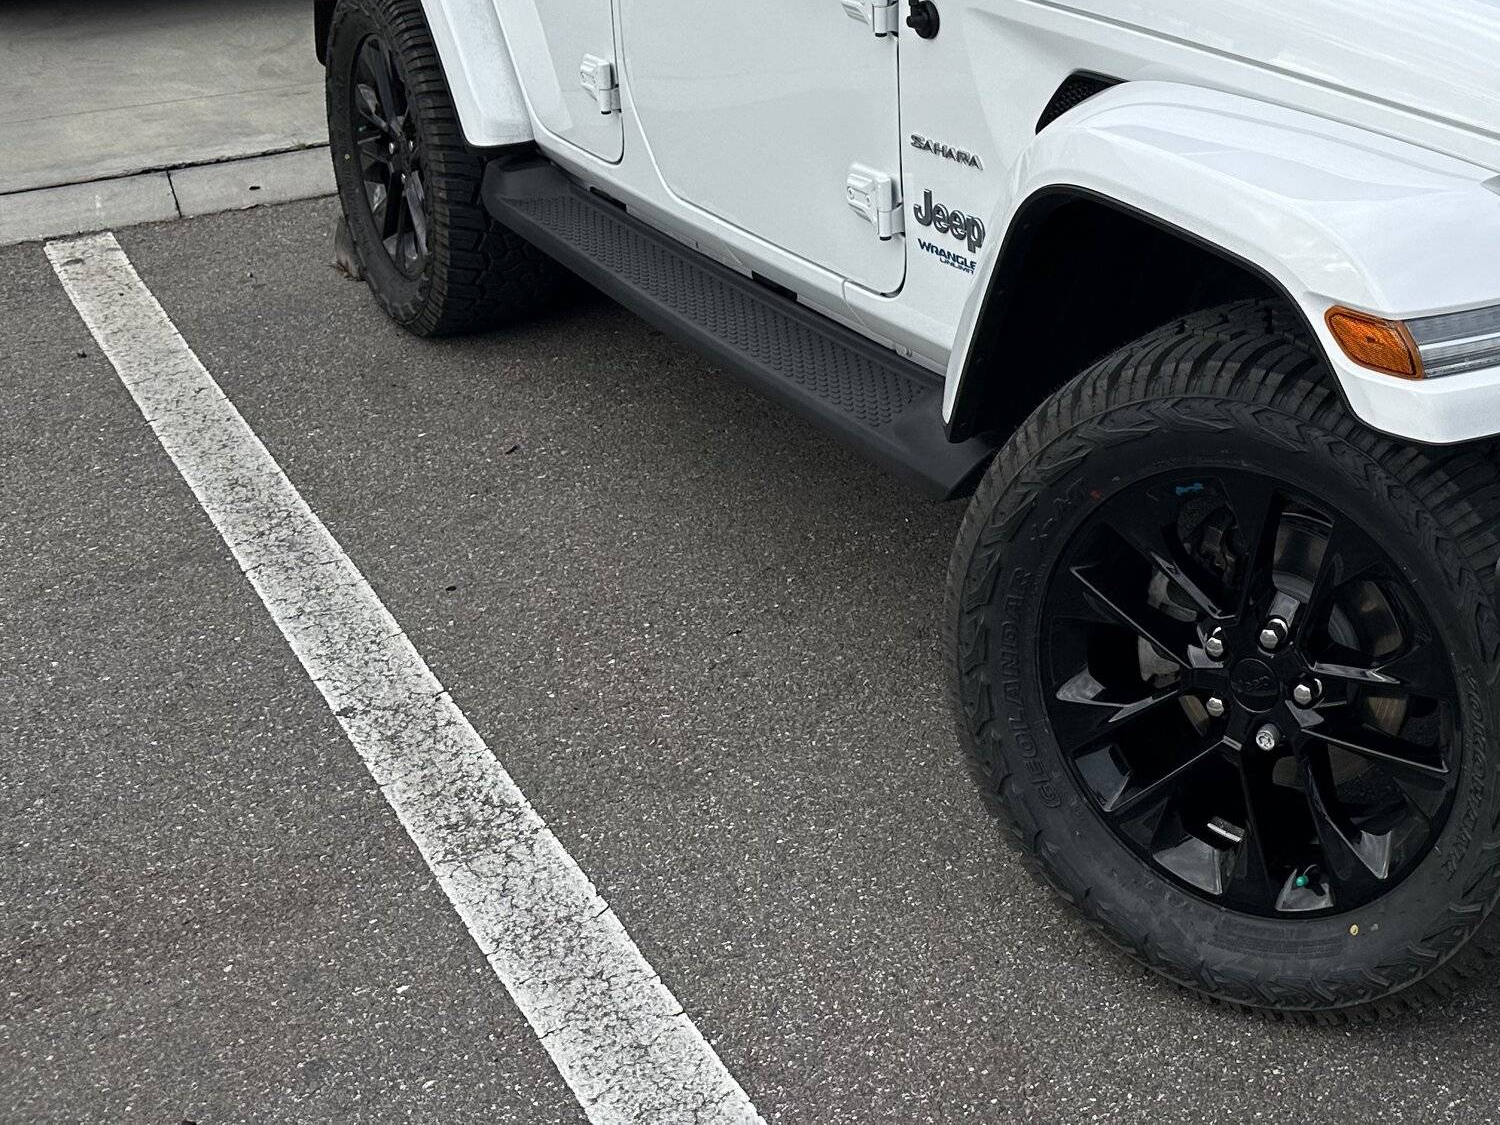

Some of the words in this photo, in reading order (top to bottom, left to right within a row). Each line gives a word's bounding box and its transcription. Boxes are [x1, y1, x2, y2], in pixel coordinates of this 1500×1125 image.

[910, 133, 984, 172] SAHARA
[913, 188, 986, 254] Jeep
[917, 237, 977, 271] WRANGLE
